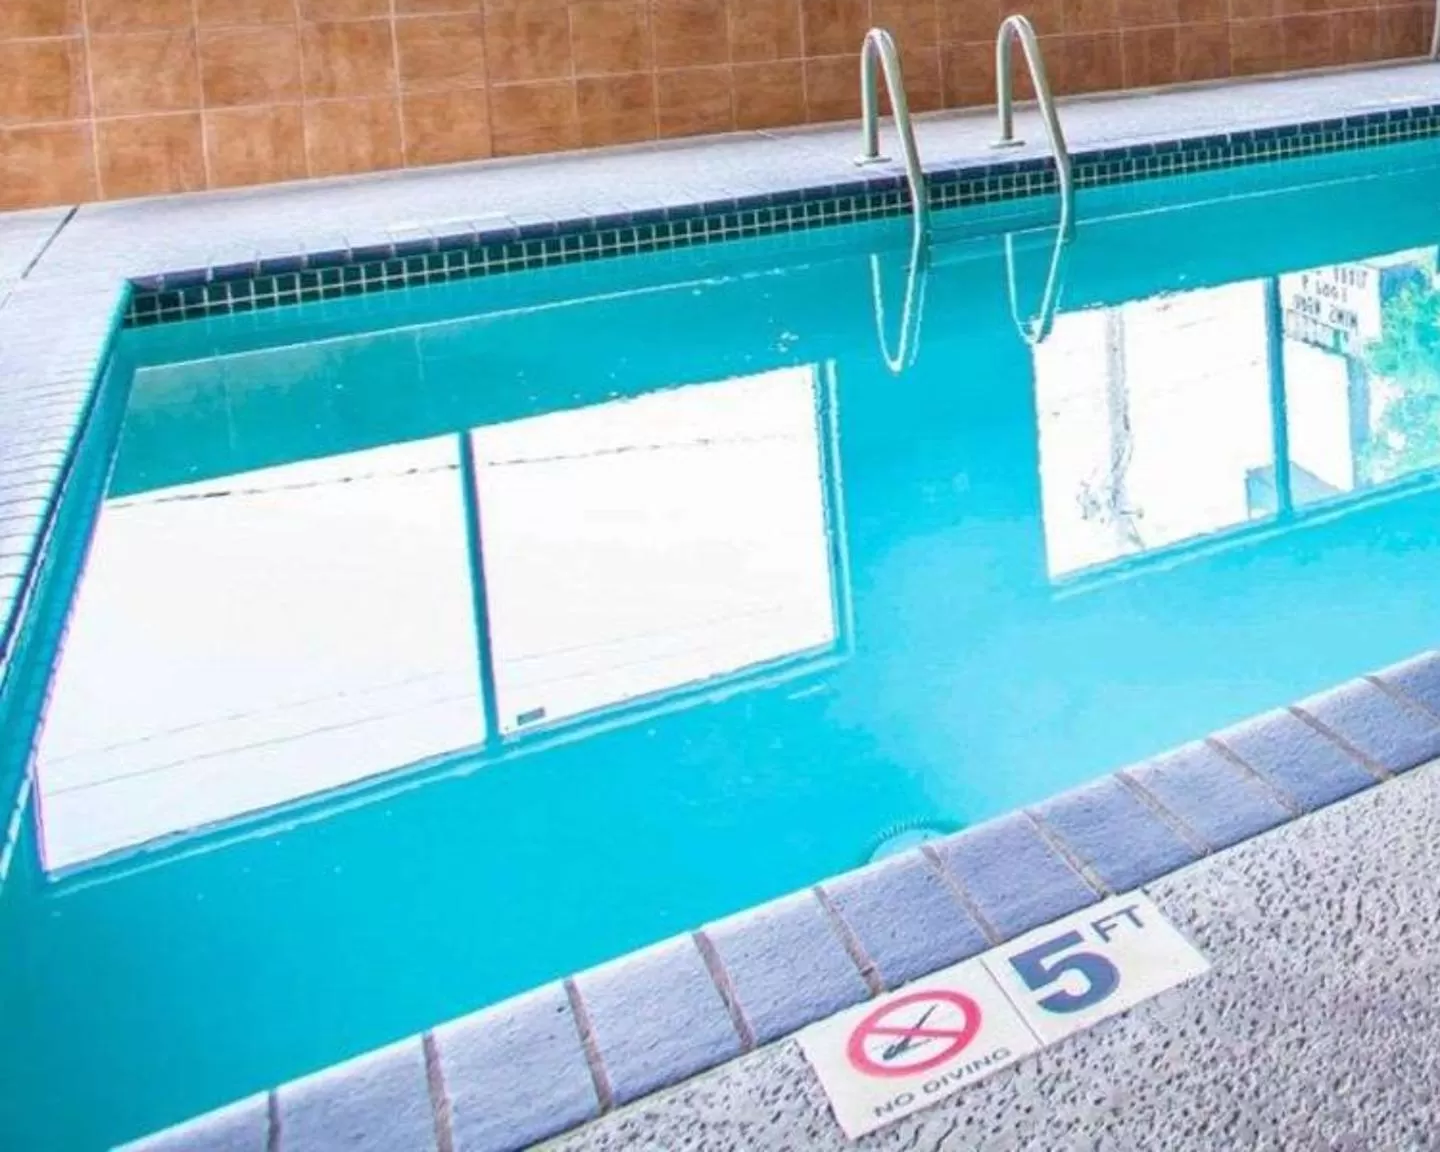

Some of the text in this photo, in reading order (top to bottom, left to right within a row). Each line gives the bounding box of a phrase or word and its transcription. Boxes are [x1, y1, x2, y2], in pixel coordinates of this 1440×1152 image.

[1009, 905, 1145, 1014] 5 FT
[873, 1049, 1012, 1117] NO DIVING
